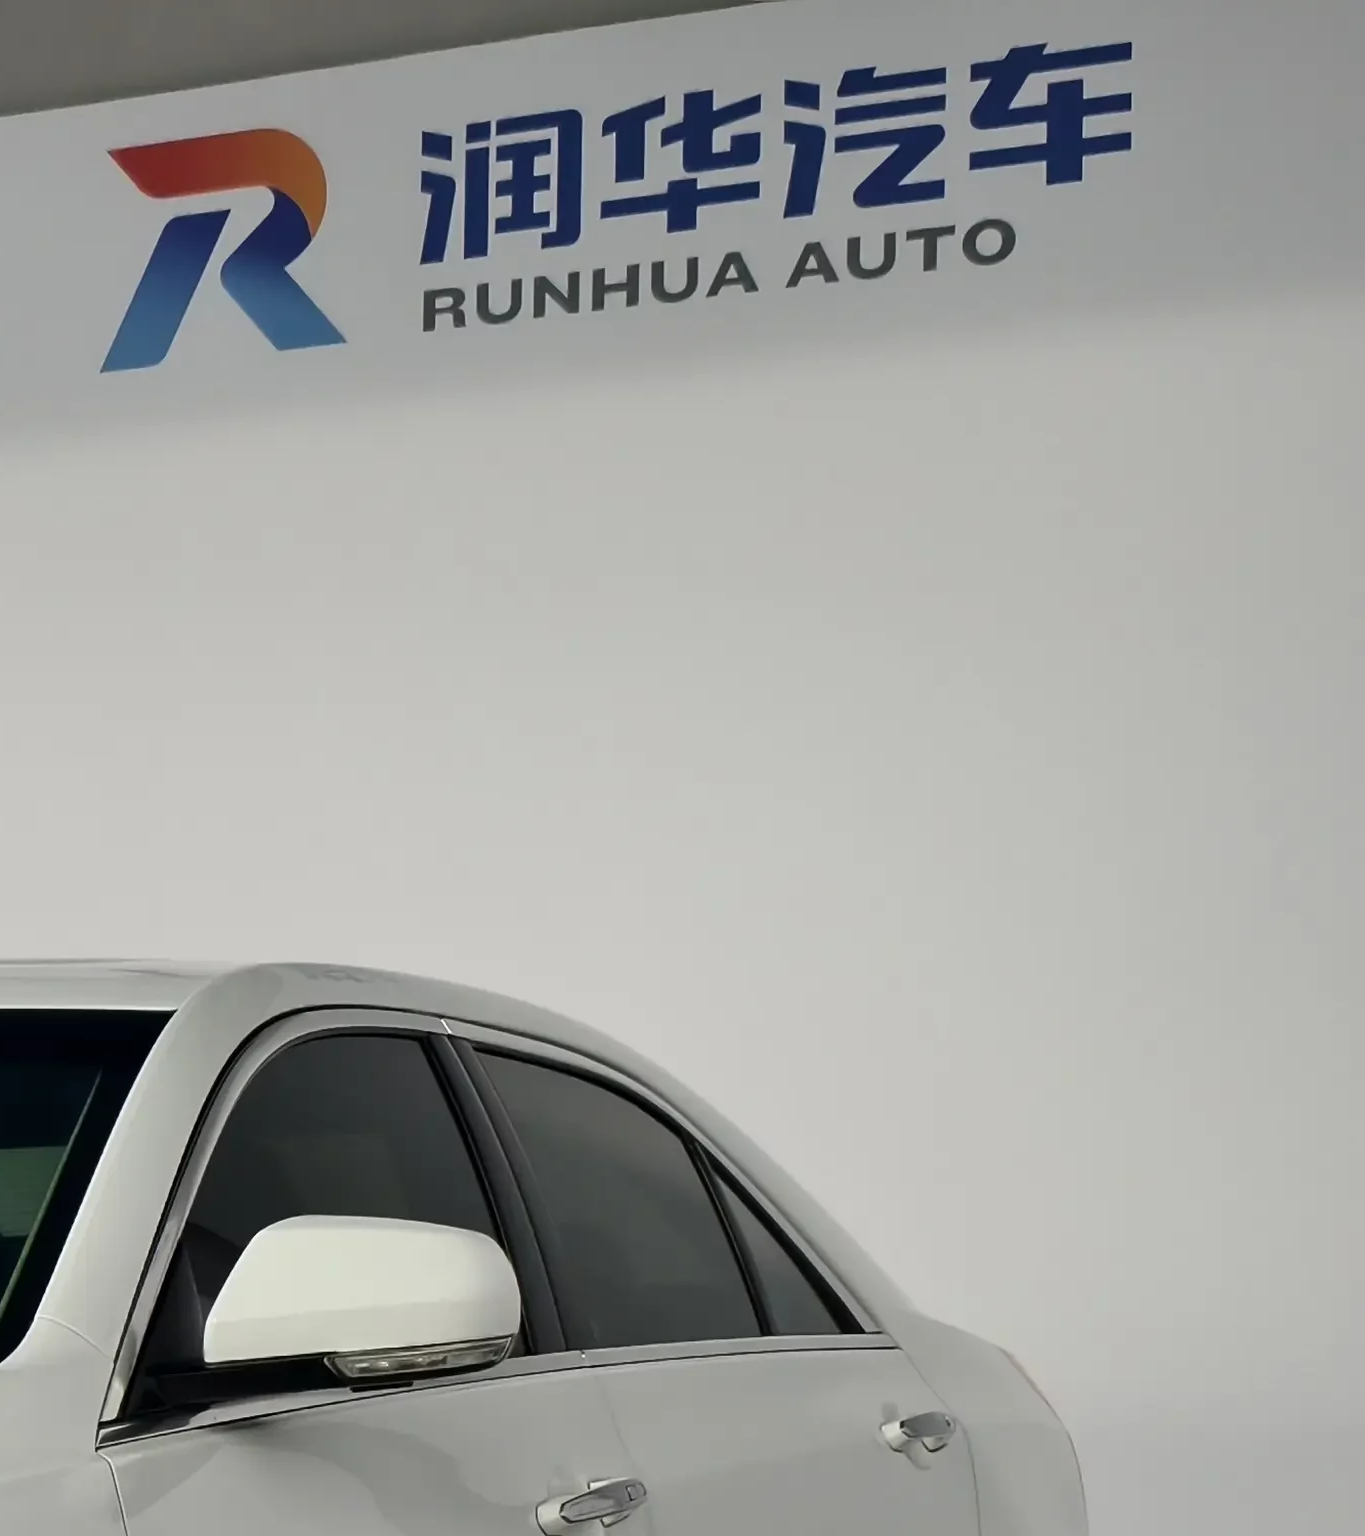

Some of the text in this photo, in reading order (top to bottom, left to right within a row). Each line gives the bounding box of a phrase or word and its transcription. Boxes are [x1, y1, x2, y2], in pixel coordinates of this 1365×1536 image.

[420, 42, 1133, 265] 润华汽车
[423, 218, 1017, 332] RUNHUA AUTO
